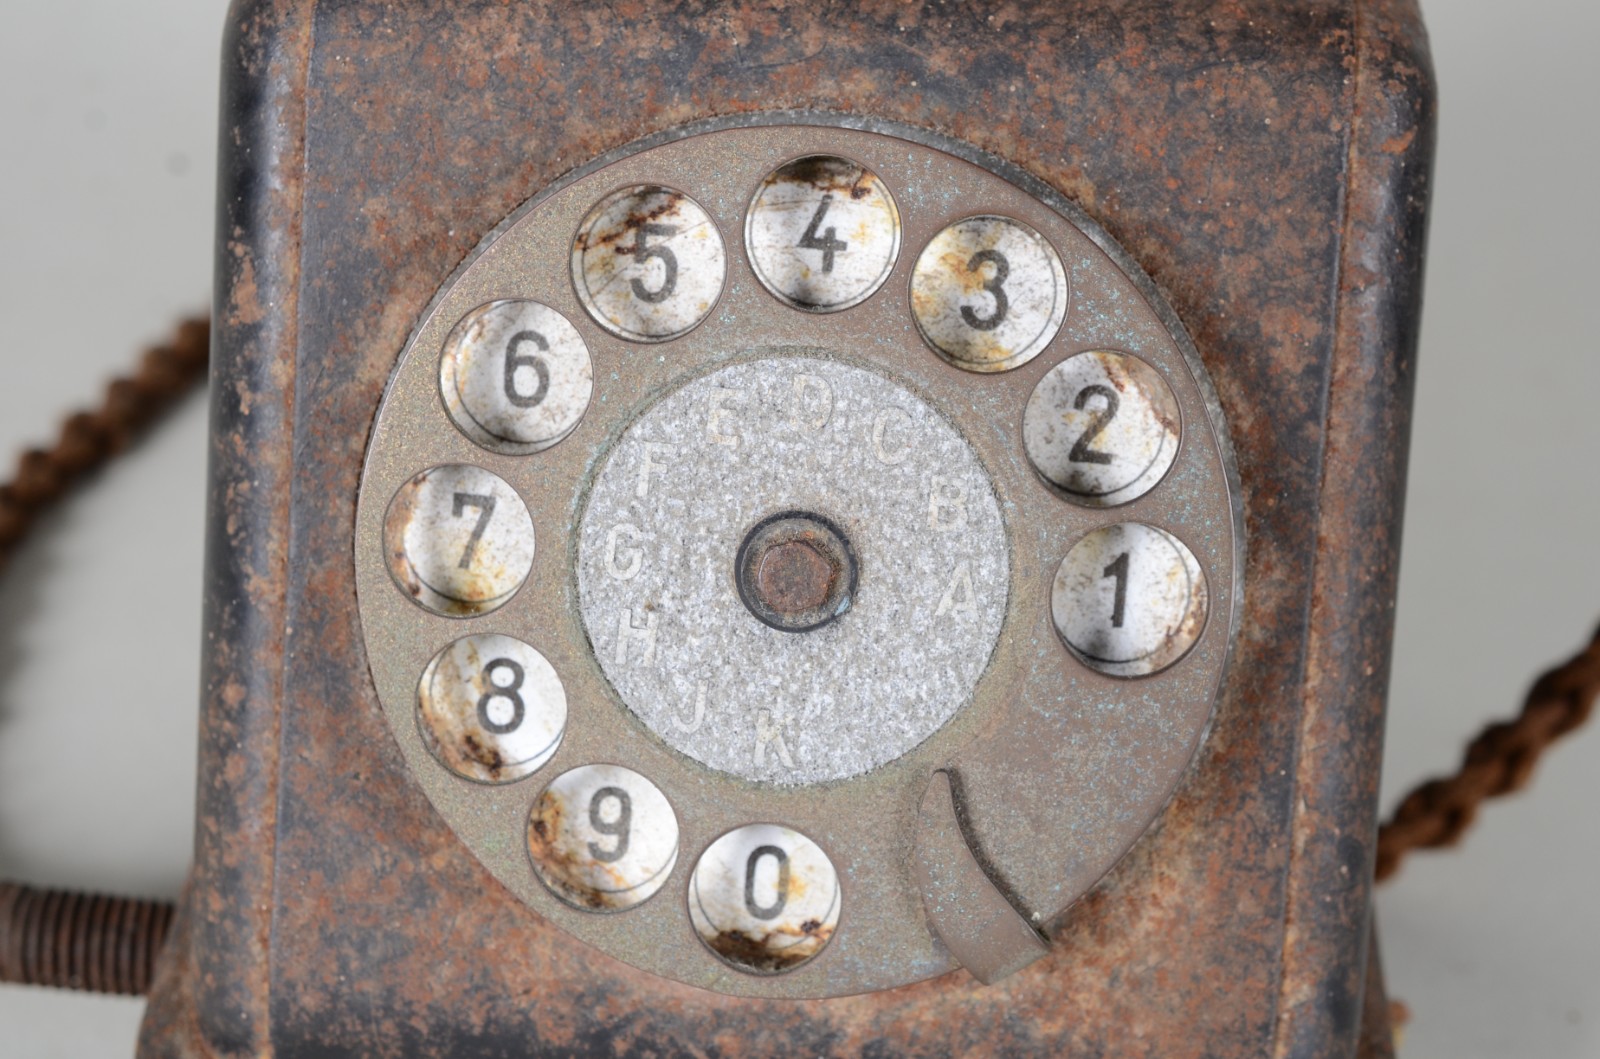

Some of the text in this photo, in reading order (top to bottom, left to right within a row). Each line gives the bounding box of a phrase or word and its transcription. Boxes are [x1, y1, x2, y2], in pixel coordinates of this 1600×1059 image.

[630, 223, 680, 303] 5
[797, 194, 847, 274] 4
[960, 249, 1010, 331] 3
[503, 330, 550, 408] 6
[707, 387, 745, 446] E
[794, 374, 833, 430] D
[1068, 384, 1119, 465] 2
[872, 407, 913, 465] C
[636, 441, 677, 497] F
[452, 492, 497, 569] 7
[927, 475, 968, 530] B
[604, 523, 643, 581] G
[934, 560, 979, 617] A
[1103, 552, 1130, 628] 1
[615, 609, 659, 668] H
[476, 657, 525, 734] 8
[670, 680, 708, 734] J
[753, 710, 795, 769] K
[587, 786, 633, 863] 9
